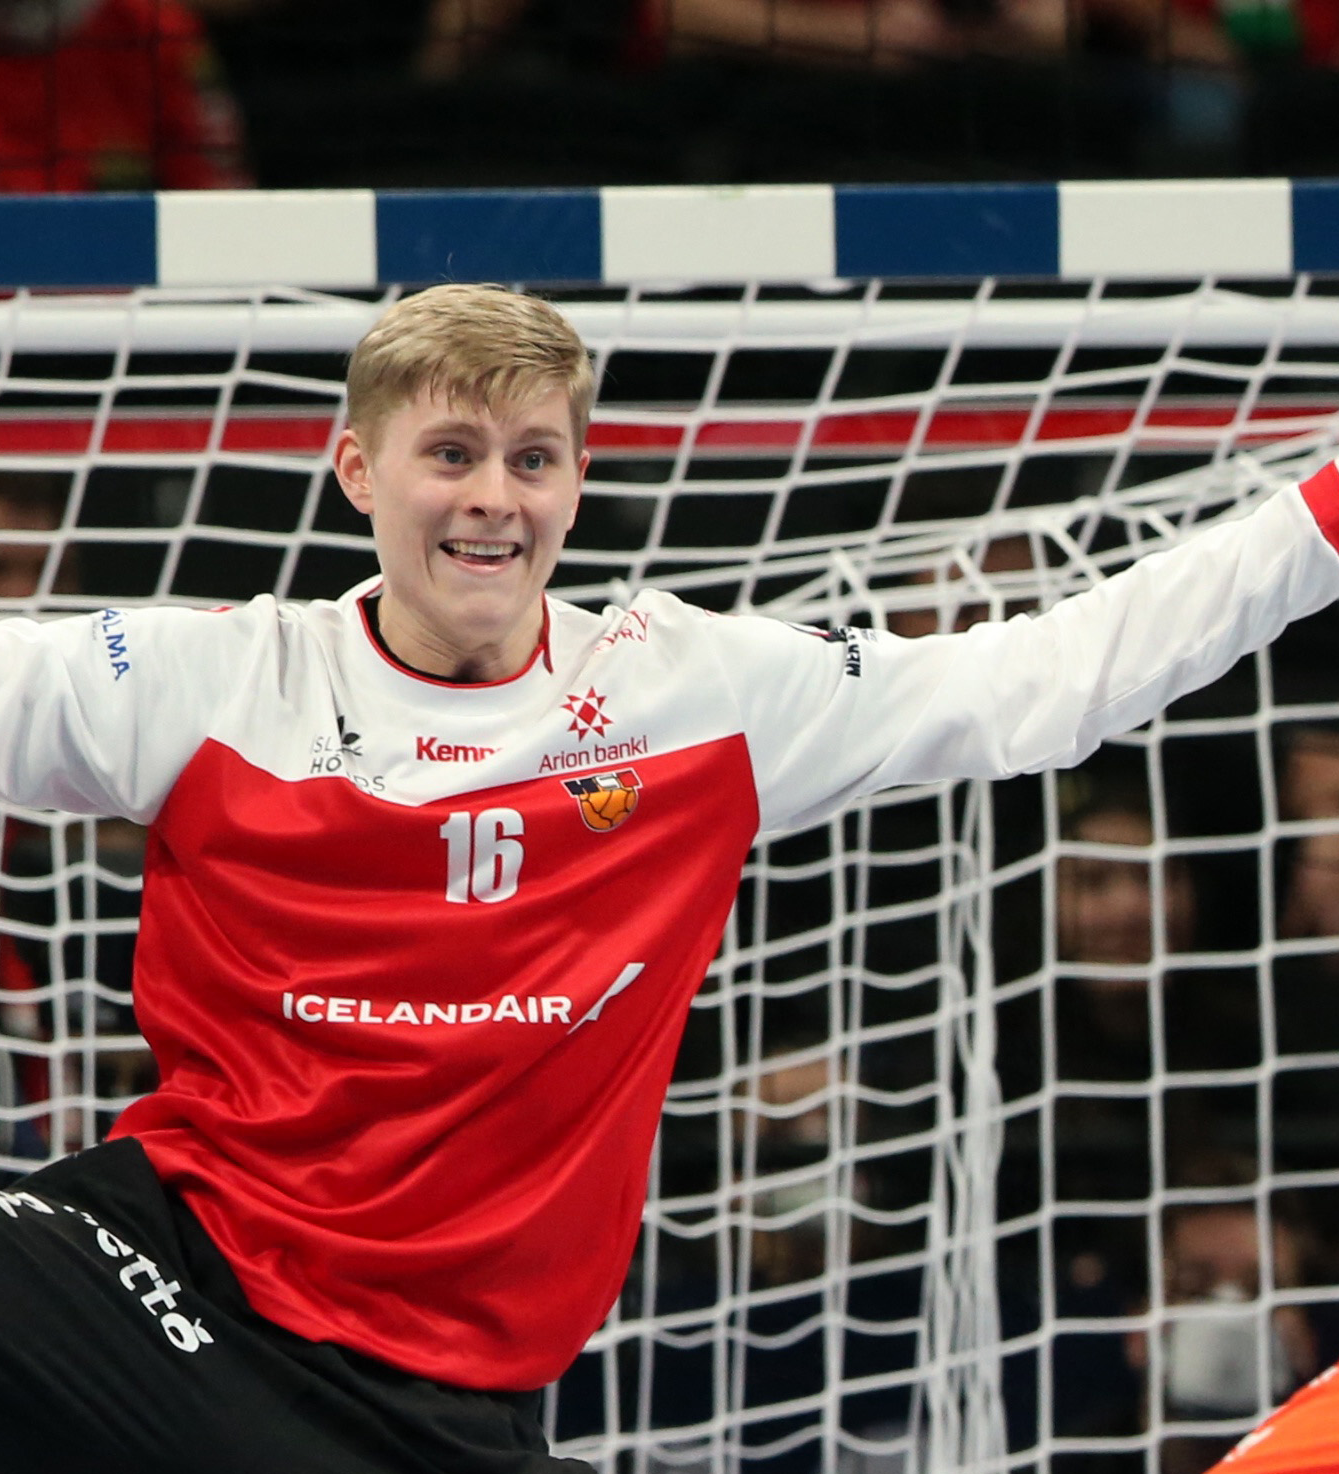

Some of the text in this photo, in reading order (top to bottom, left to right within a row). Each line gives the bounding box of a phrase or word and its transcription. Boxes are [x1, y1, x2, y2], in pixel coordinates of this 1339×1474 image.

[538, 735, 649, 774] Arion banki
[439, 807, 525, 904] 16
[282, 992, 573, 1025] ICELANDAIR
